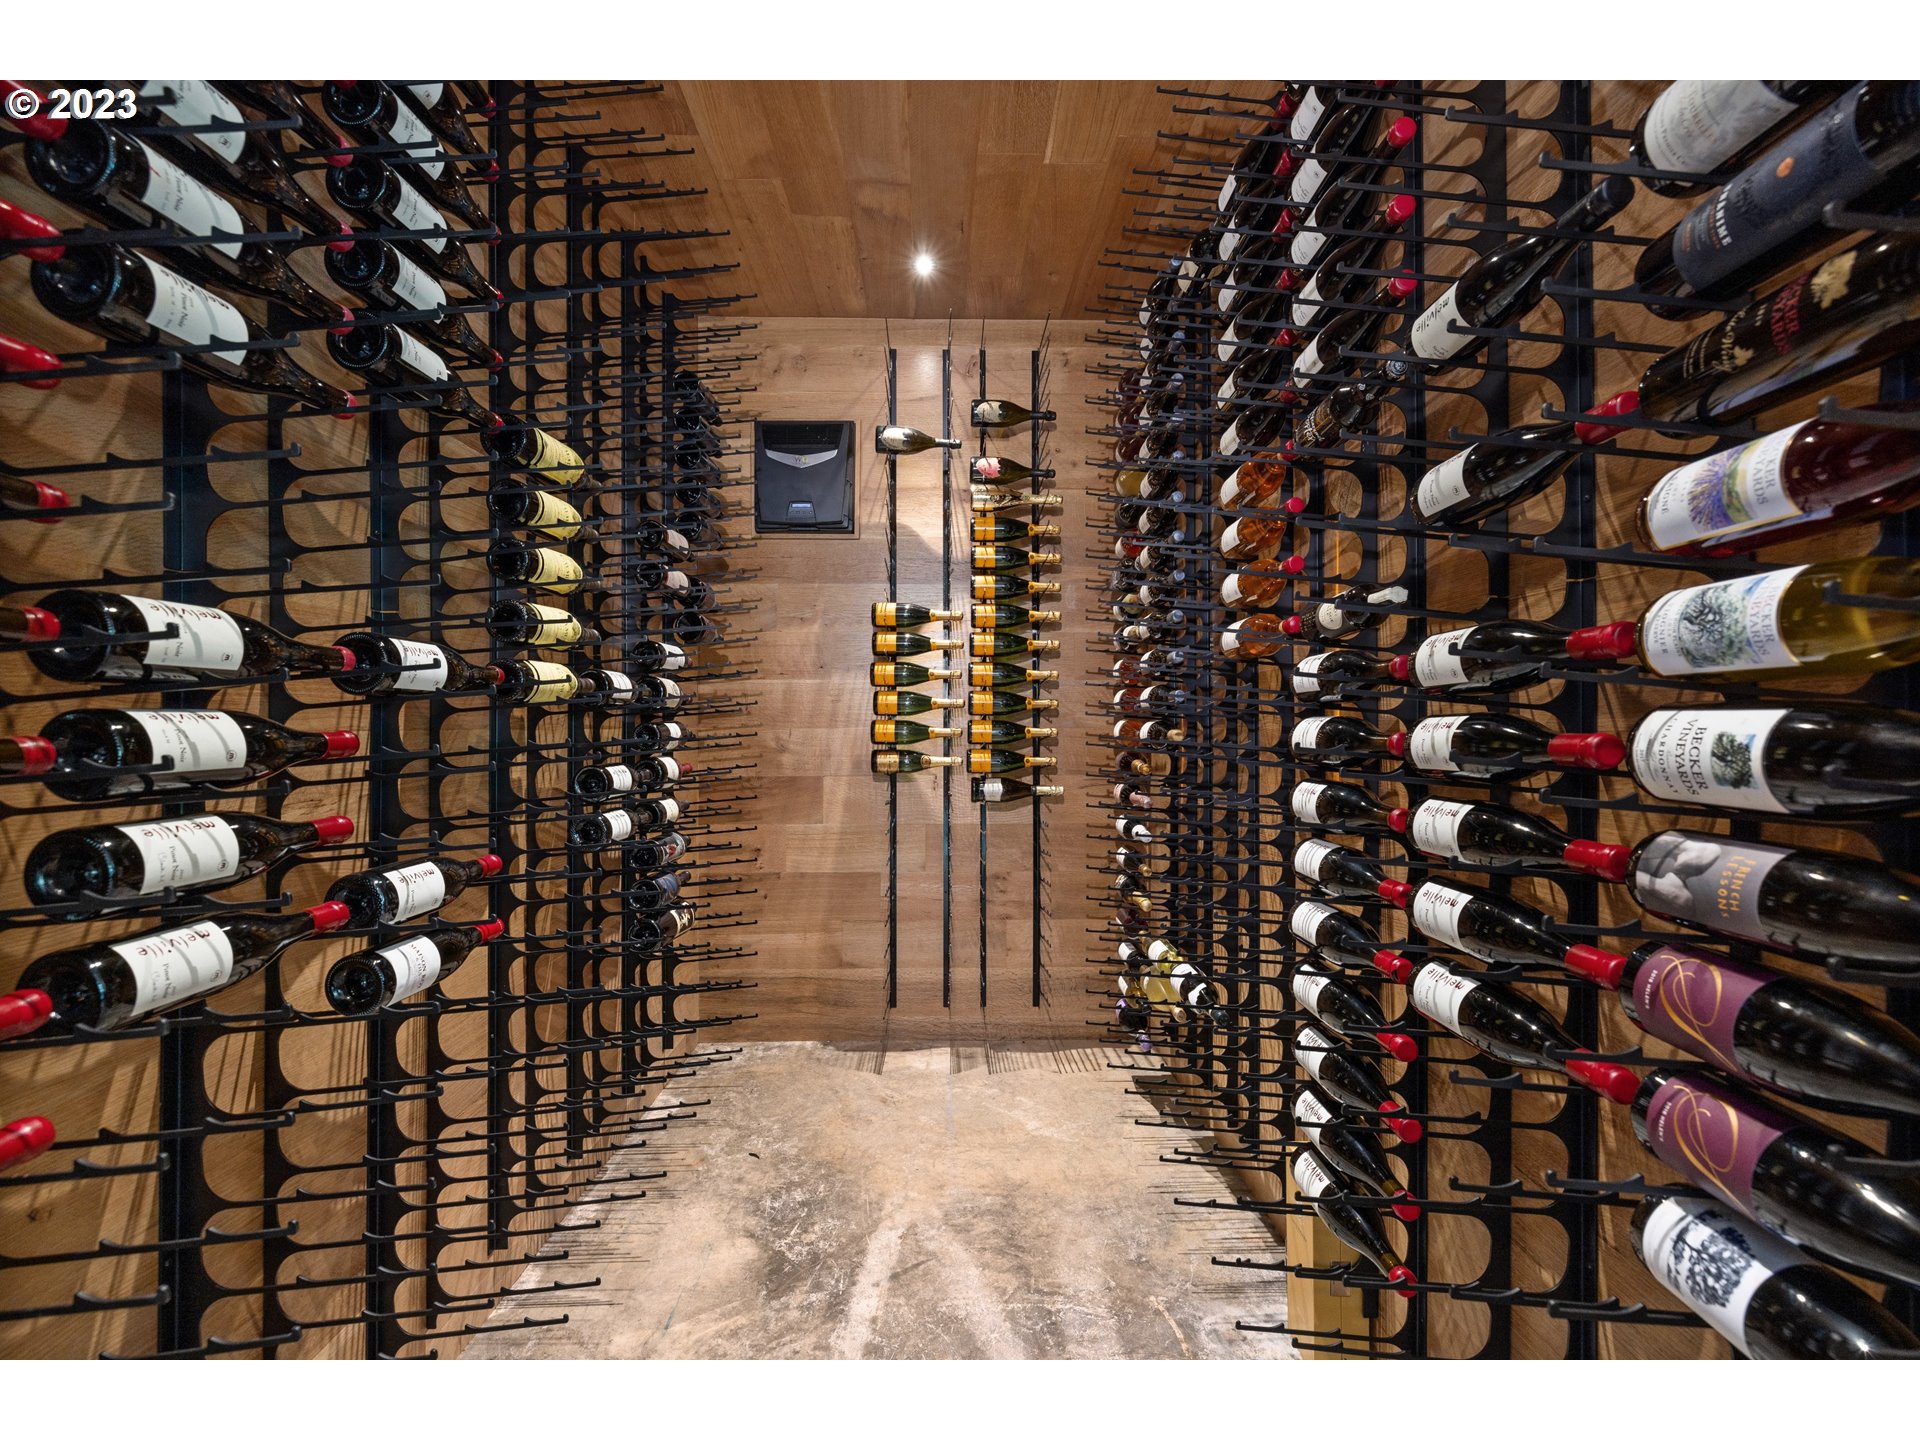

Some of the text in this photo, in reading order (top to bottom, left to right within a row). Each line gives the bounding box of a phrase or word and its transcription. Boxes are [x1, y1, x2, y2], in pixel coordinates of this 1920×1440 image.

[1416, 296, 1449, 333] melville
[150, 602, 222, 621] melville
[1420, 722, 1454, 733] melville
[1674, 719, 1699, 796] VINEYARDS
[1689, 727, 1709, 790] BECKER
[1423, 805, 1459, 819] melville
[142, 820, 216, 840] melville
[400, 867, 435, 884] melville
[1717, 855, 1745, 918] LESSONS
[1730, 859, 1757, 911] FRENCH
[1423, 889, 1459, 908] melville
[137, 928, 210, 959] melville
[1427, 968, 1465, 990] melville
[1301, 1097, 1323, 1122] melville
[1303, 1156, 1326, 1183] melville
